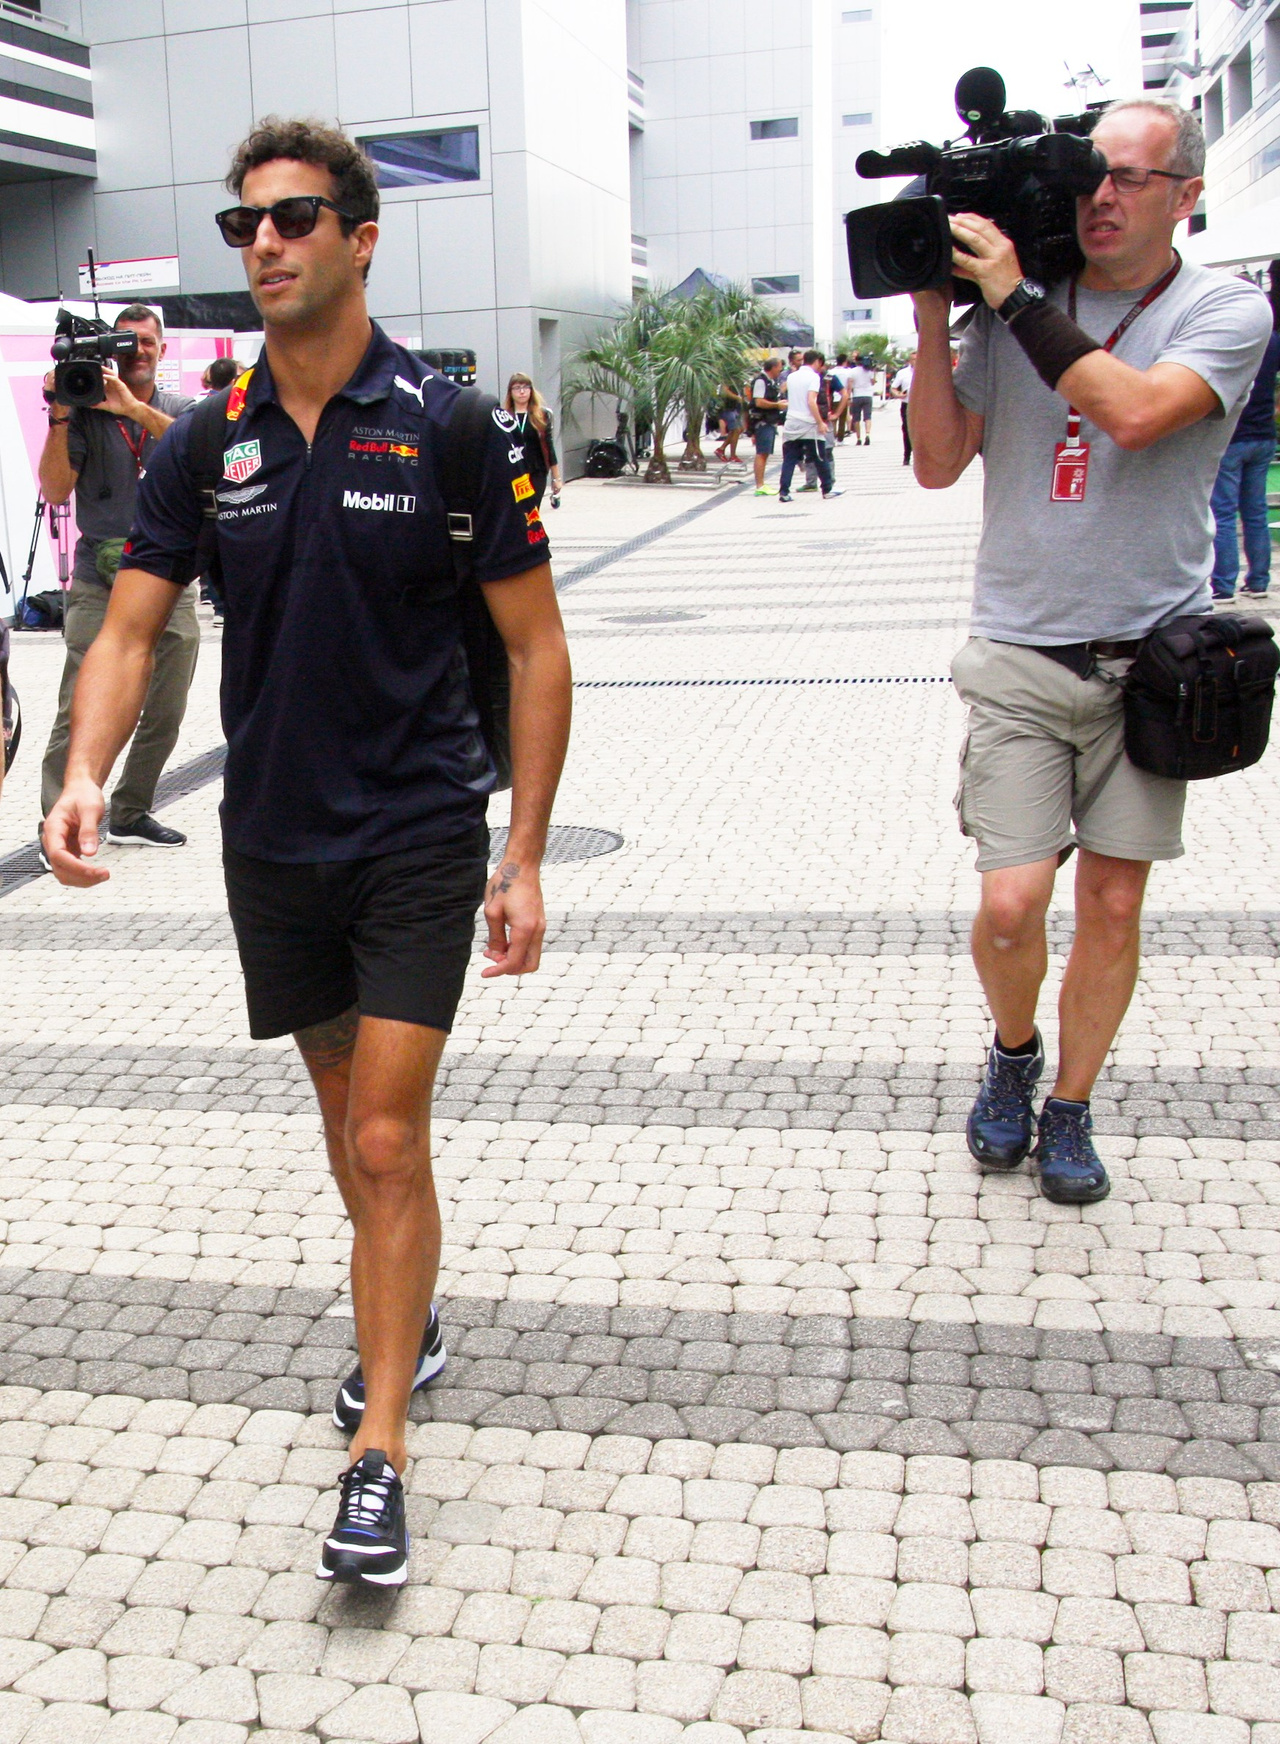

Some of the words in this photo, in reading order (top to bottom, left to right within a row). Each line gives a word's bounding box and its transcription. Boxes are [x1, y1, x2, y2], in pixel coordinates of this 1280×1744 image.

[352, 426, 383, 437] ASTON
[385, 429, 420, 441] MARTIN
[226, 441, 258, 463] TAG
[349, 440, 369, 451] Red
[370, 441, 389, 453] Bull
[347, 452, 419, 466] RACING
[342, 489, 395, 512] Mobil
[218, 509, 239, 521] STON
[241, 502, 278, 517] MARTIN
